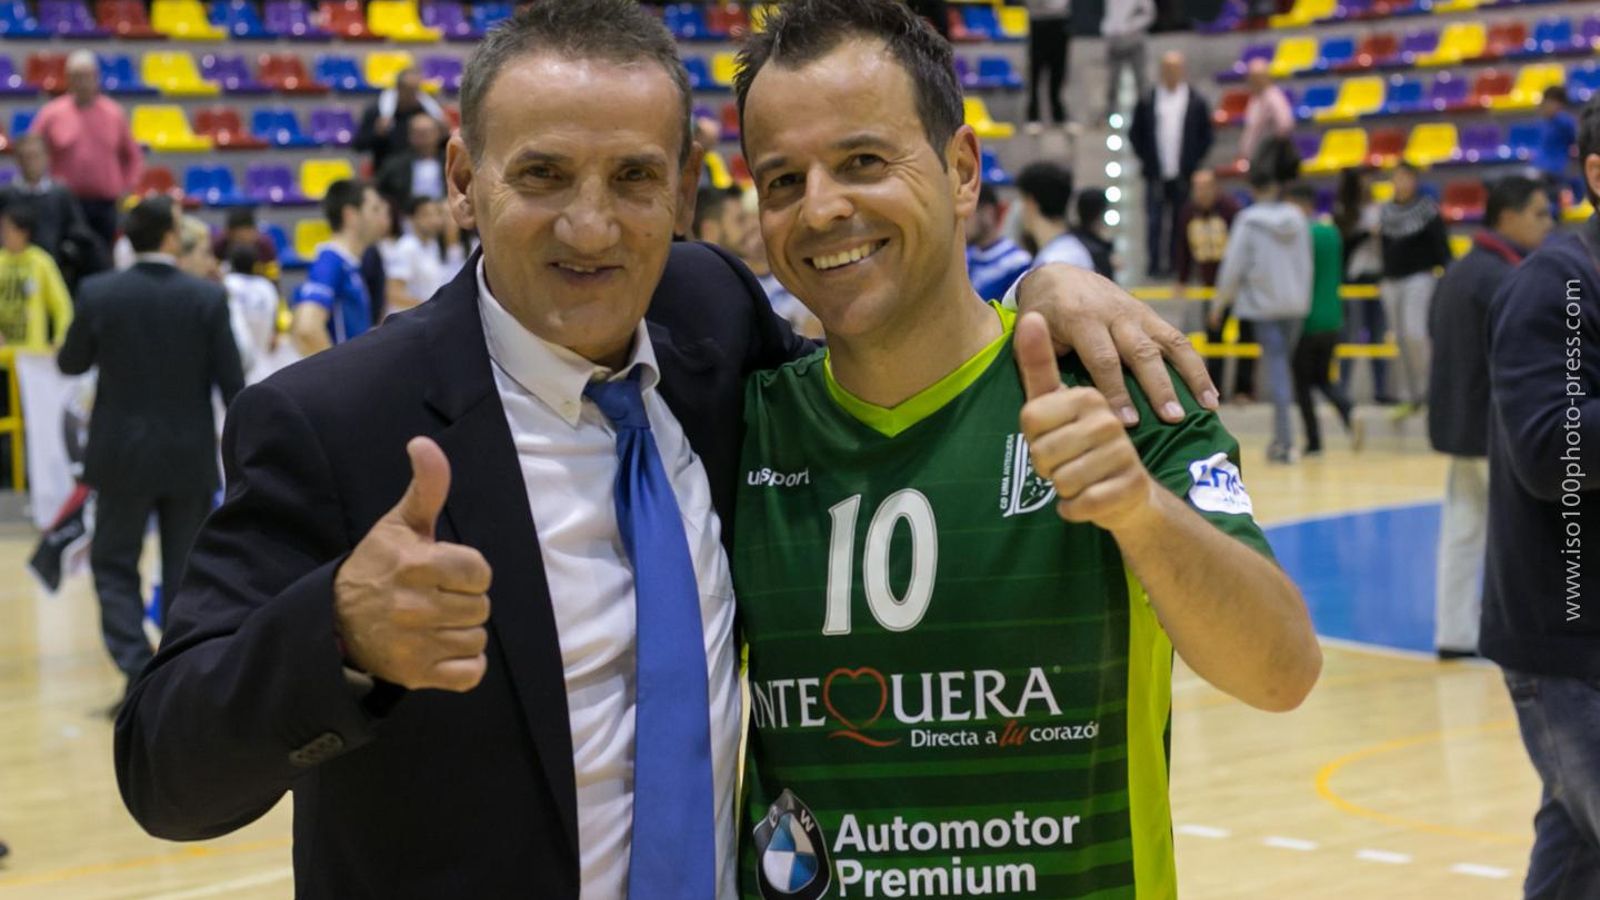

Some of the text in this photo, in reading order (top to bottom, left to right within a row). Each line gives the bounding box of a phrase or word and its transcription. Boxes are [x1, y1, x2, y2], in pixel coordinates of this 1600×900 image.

[822, 487, 938, 636] 10
[910, 729, 980, 748] Directa
[985, 730, 998, 744] a
[1029, 720, 1099, 743] corazó
[833, 811, 1081, 853] Automotor
[836, 855, 1037, 898] Premium
